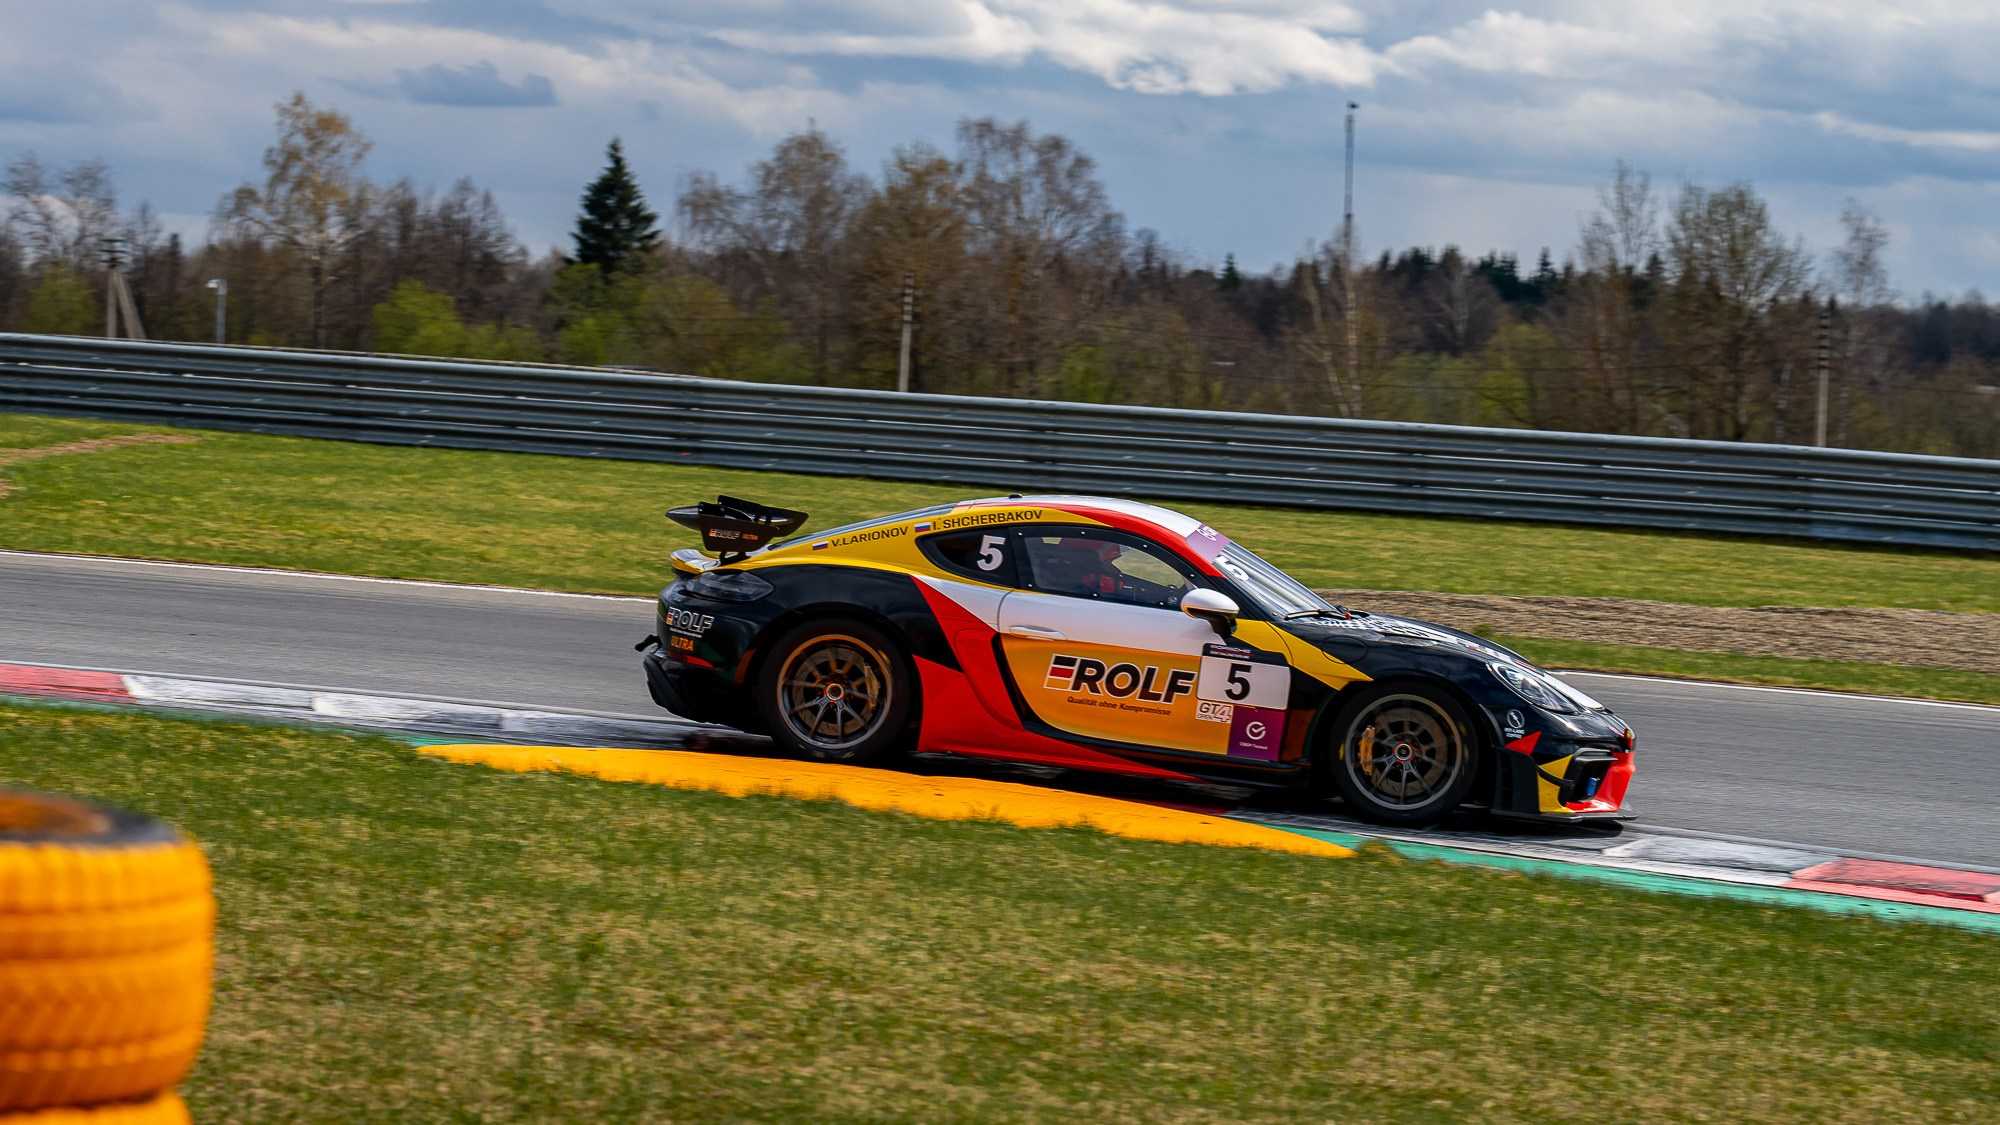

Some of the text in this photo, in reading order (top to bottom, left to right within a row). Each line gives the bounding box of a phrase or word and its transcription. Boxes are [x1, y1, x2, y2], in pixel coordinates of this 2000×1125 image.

[943, 510, 1043, 529] SHCHERBAKOV
[831, 526, 908, 547] V.LARIONOV
[976, 534, 1006, 571] 5
[1214, 555, 1250, 581] 5
[670, 608, 715, 634] ROLF
[671, 635, 694, 652] ULTRA
[1071, 658, 1197, 705] ROLF
[1224, 662, 1253, 701] 5
[1066, 695, 1172, 716] Qualität ohne Kompromisse
[1199, 702, 1232, 722] GT4
